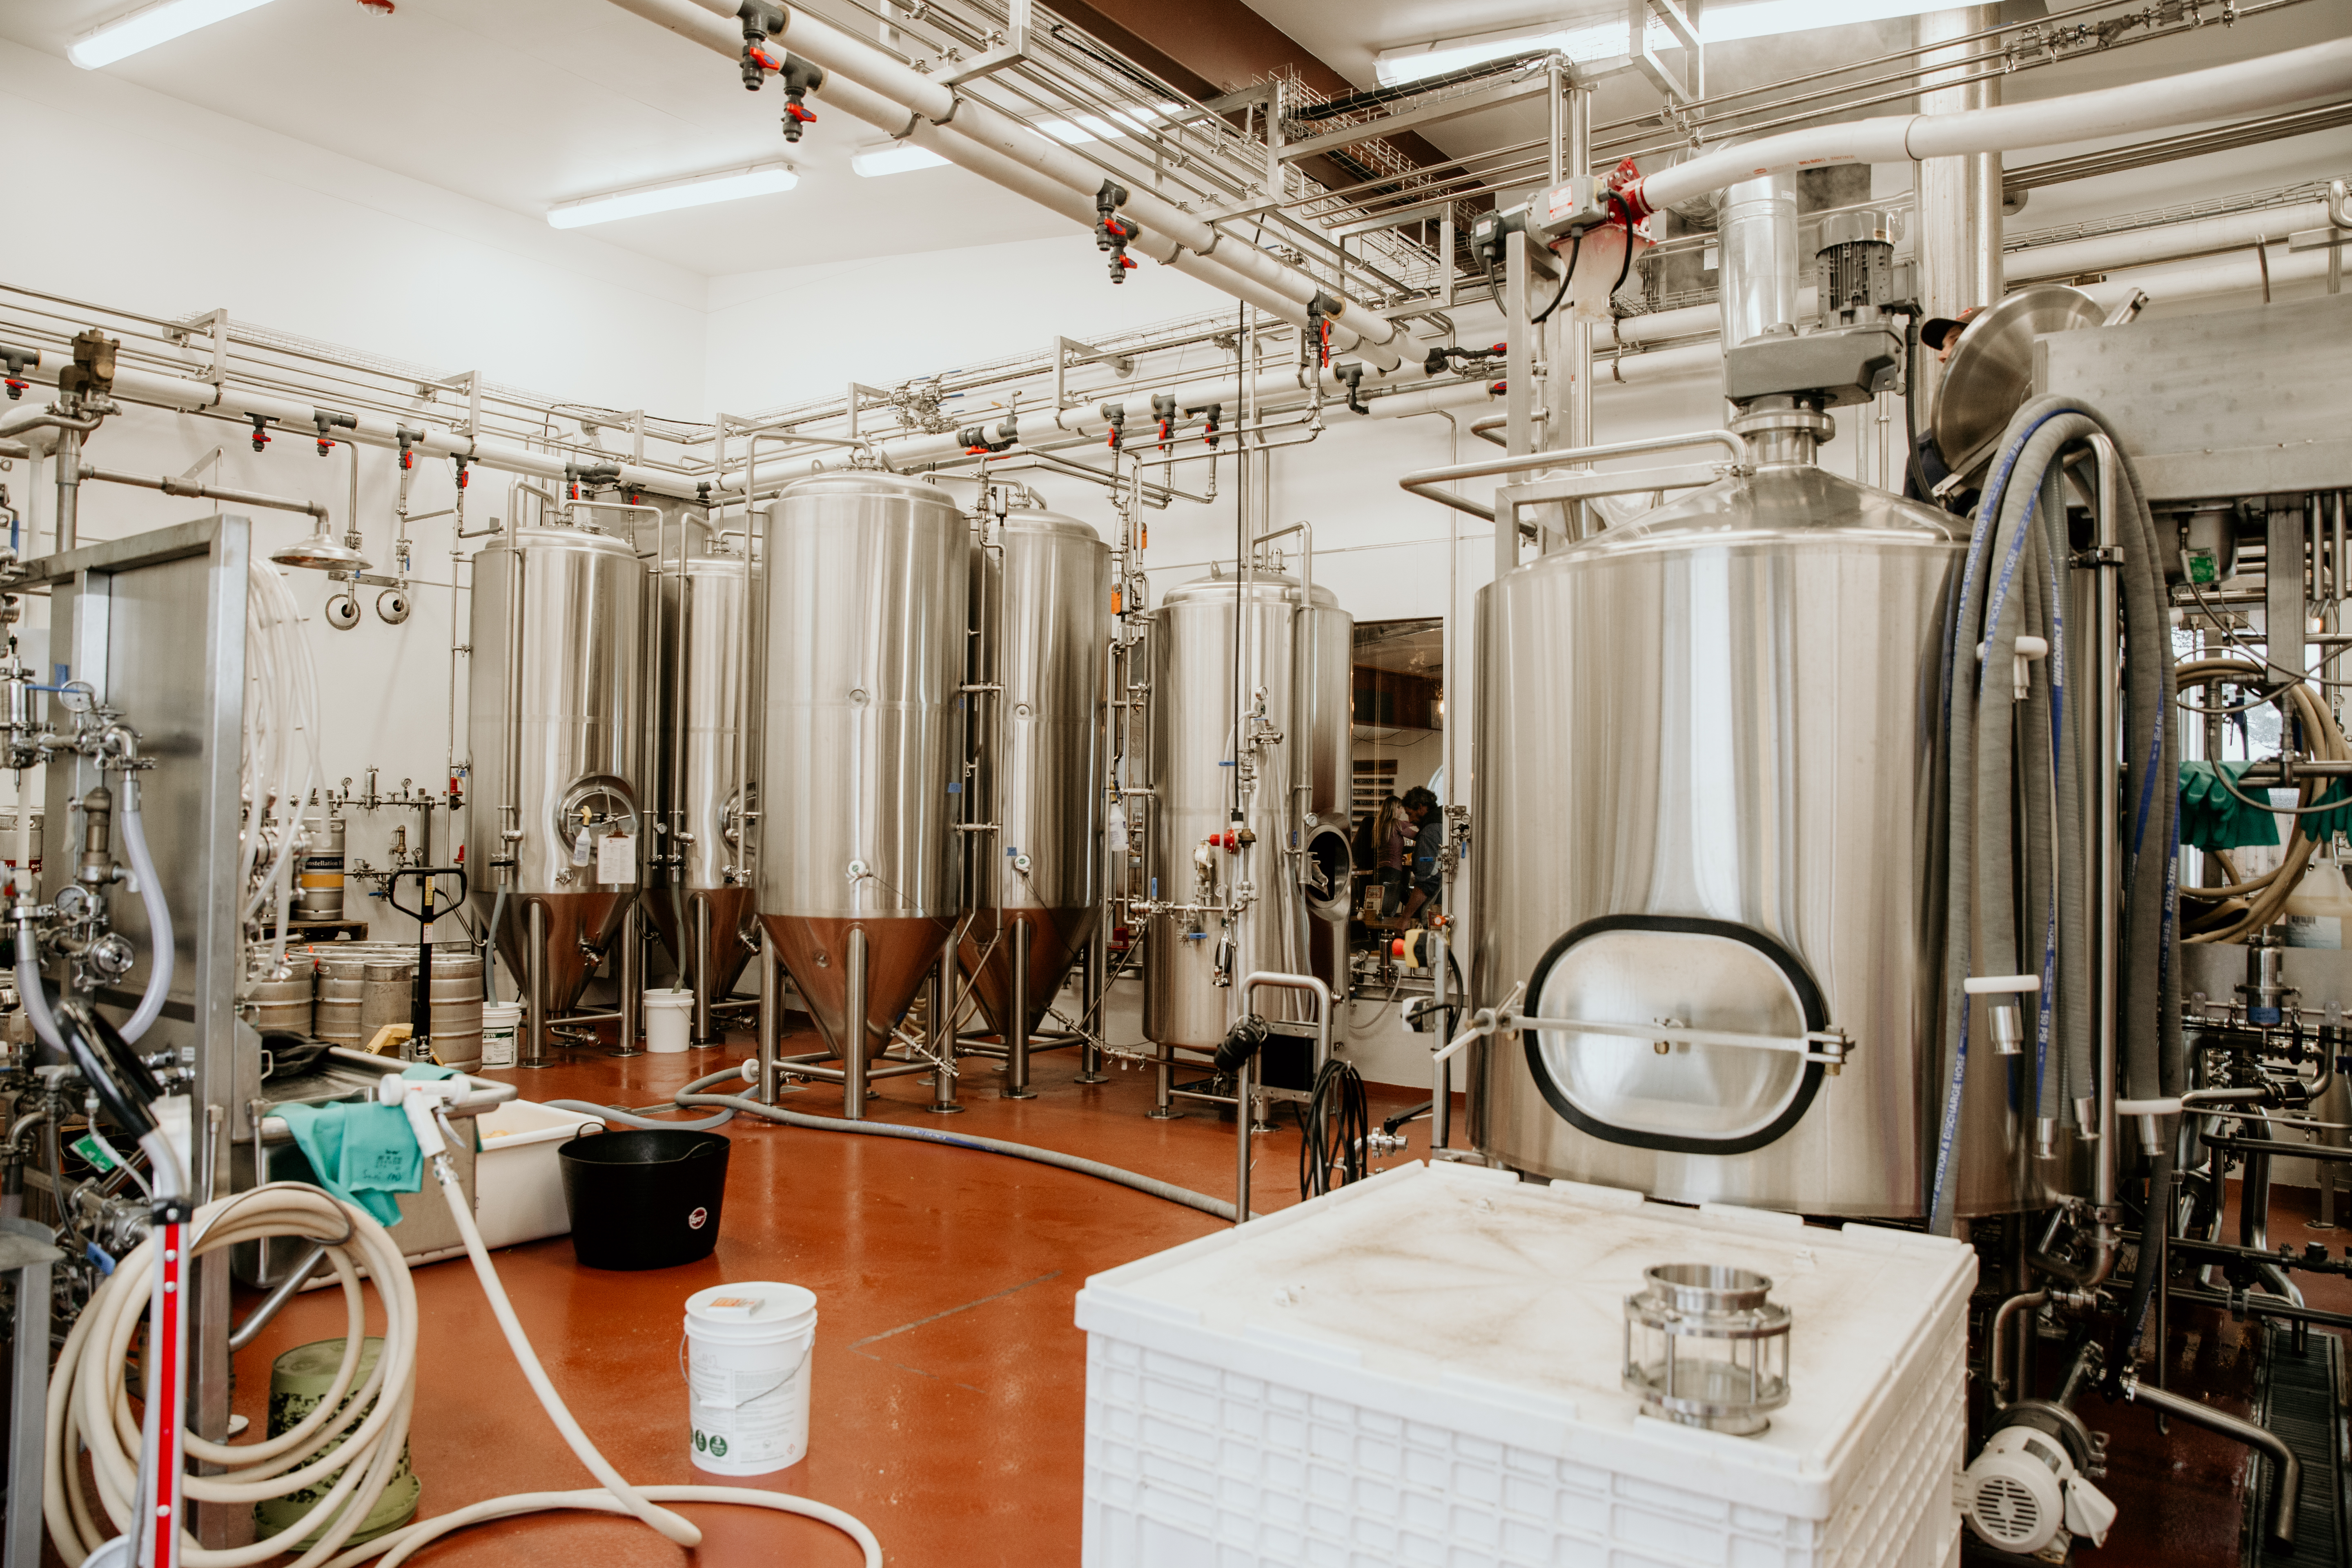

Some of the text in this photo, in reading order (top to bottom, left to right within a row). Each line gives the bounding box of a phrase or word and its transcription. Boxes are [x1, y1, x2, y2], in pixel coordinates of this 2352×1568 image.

[2040, 1009, 2049, 1026] 150
[2039, 1027, 2048, 1043] PSI
[1954, 1053, 1965, 1082] HOSE
[1942, 1083, 1960, 1140] DISCHARGE
[1941, 1141, 1950, 1150] &
[715, 1436, 721, 1444] 3
